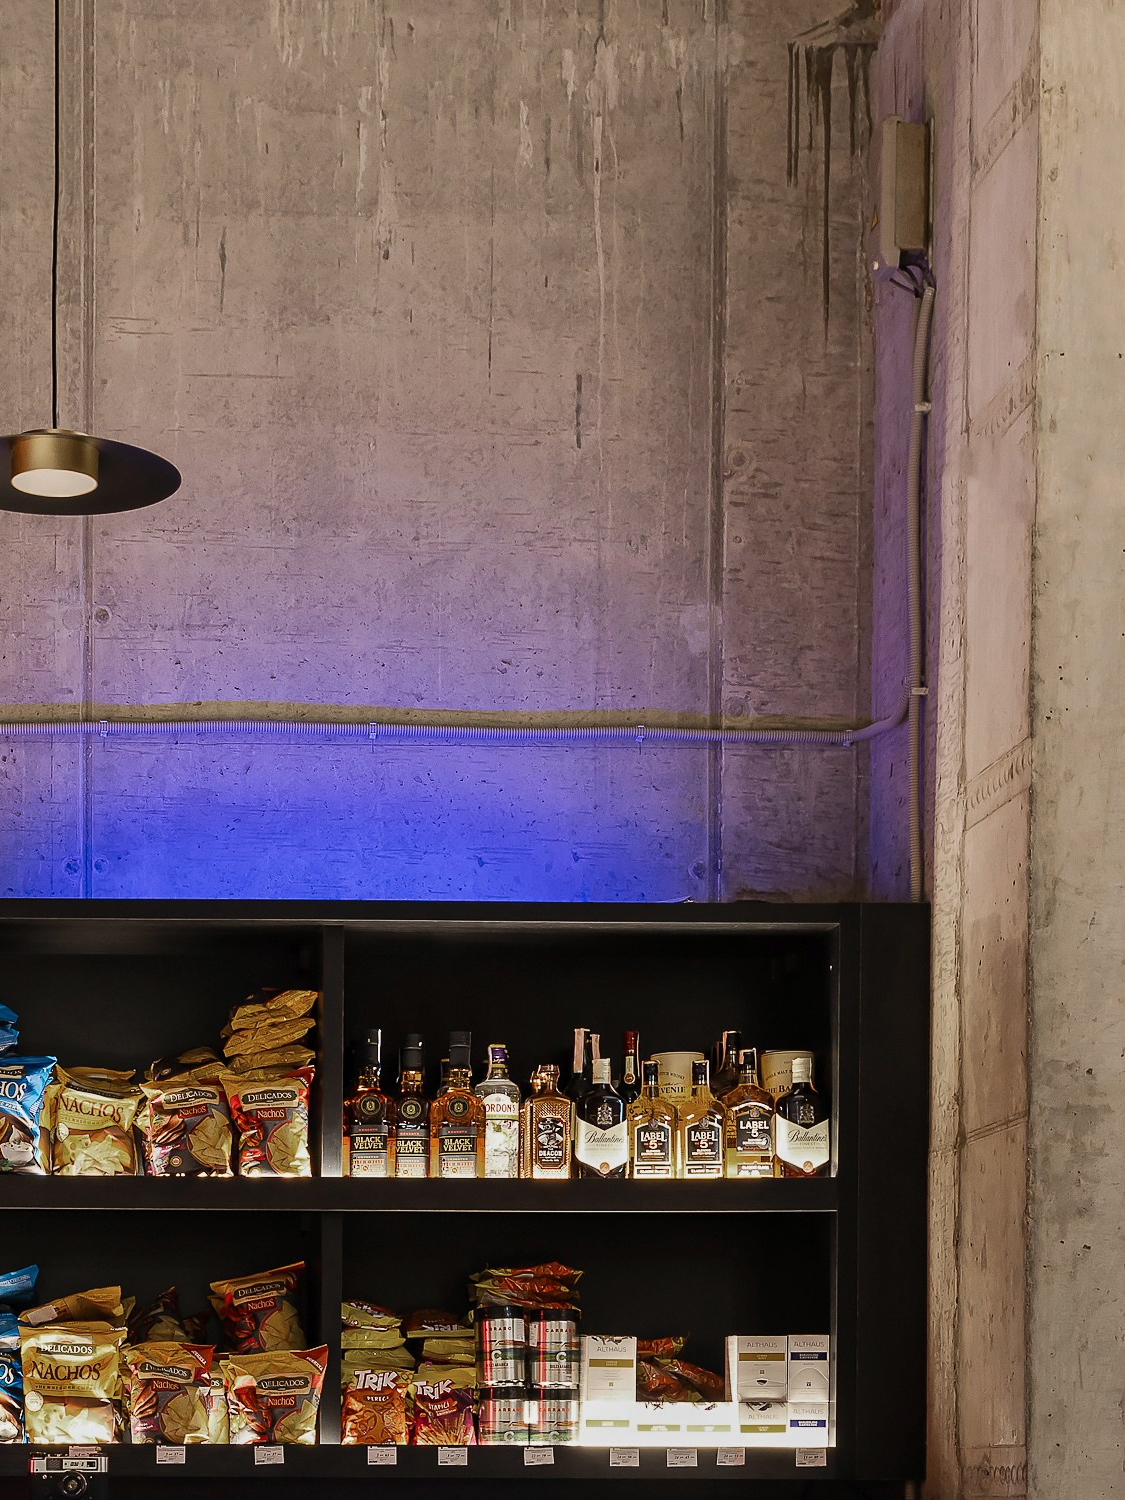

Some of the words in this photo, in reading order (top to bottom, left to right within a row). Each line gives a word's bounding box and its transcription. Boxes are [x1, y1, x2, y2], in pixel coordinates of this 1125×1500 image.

[169, 1090, 213, 1102] DELICADOS
[247, 1092, 293, 1102] DELICADOS
[59, 1097, 124, 1123] NACHOS
[739, 1120, 769, 1130] LABEL
[640, 1132, 665, 1142] LABEL
[691, 1131, 717, 1142] LABEL
[751, 1129, 759, 1138] 5
[353, 1142, 383, 1150] VELVET
[396, 1146, 424, 1154] VELVET
[443, 1144, 473, 1152] VELVET
[649, 1140, 658, 1150] 5
[699, 1140, 709, 1150] 5
[237, 1282, 282, 1297] DELICADOS
[40, 1344, 93, 1355] DELICADOS
[31, 1360, 101, 1381] NACHOS
[145, 1363, 188, 1378] DELICADOS
[259, 1378, 305, 1390] DELICADOS
